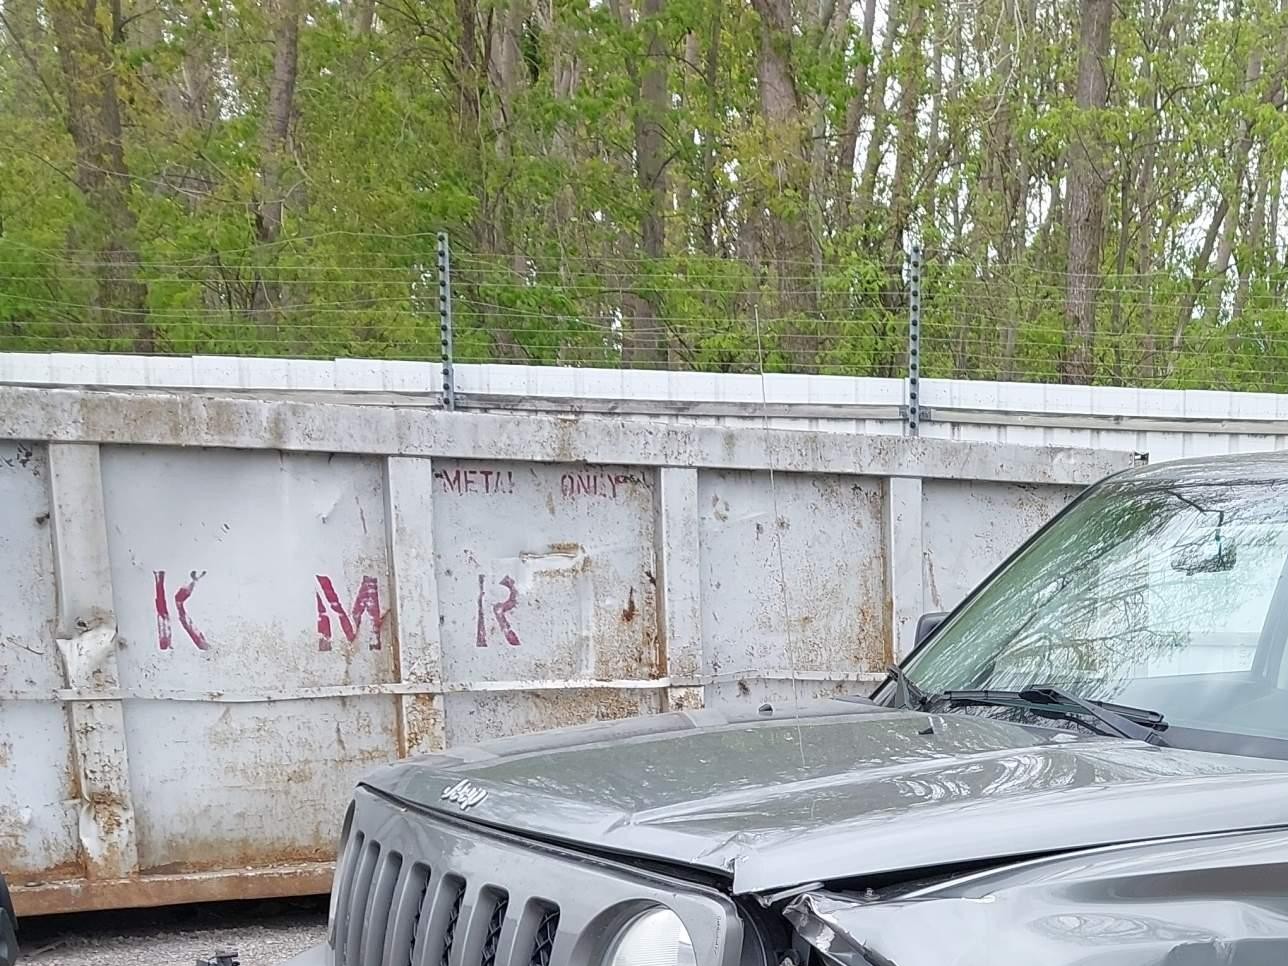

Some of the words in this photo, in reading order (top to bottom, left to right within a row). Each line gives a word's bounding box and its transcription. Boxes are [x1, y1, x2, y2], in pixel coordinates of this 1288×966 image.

[153, 570, 210, 650] K
[315, 574, 383, 652] M
[476, 573, 522, 648] R
[440, 778, 488, 811] Jeep
